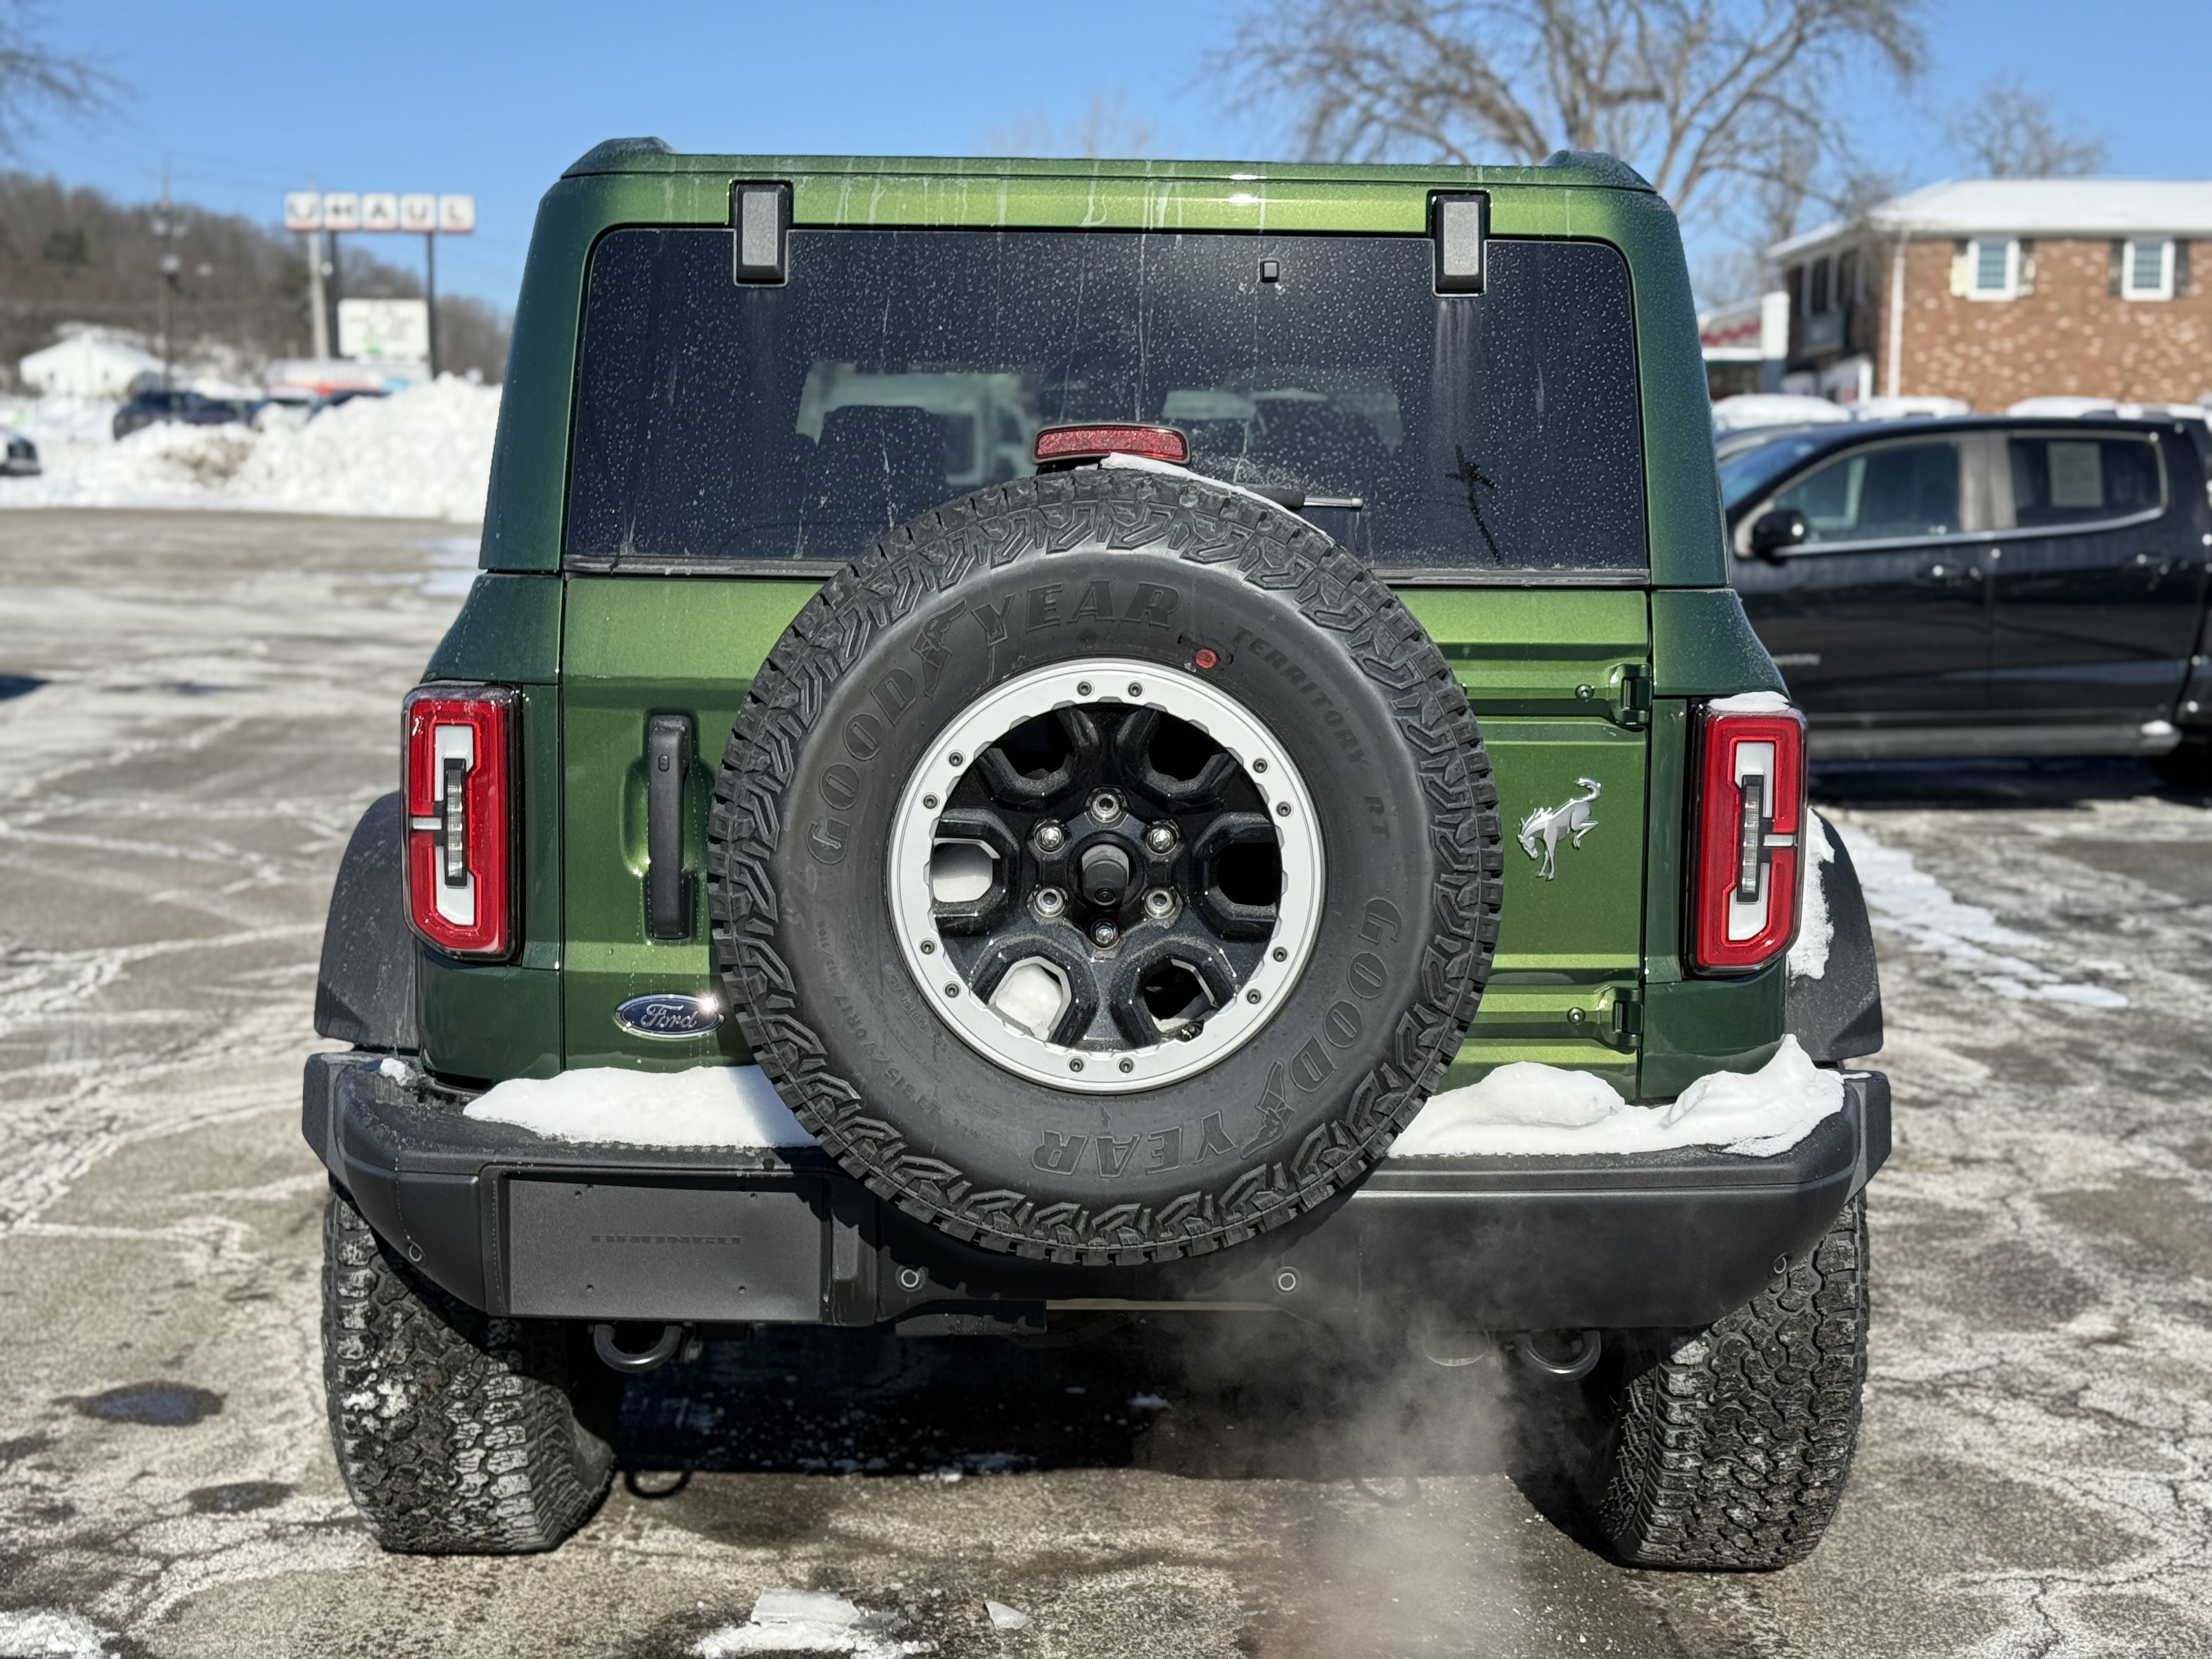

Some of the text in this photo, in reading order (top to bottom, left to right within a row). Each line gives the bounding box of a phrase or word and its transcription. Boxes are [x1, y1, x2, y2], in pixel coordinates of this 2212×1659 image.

[1232, 625, 1391, 840] TERRITORY RT
[641, 1003, 699, 1028] Ford
